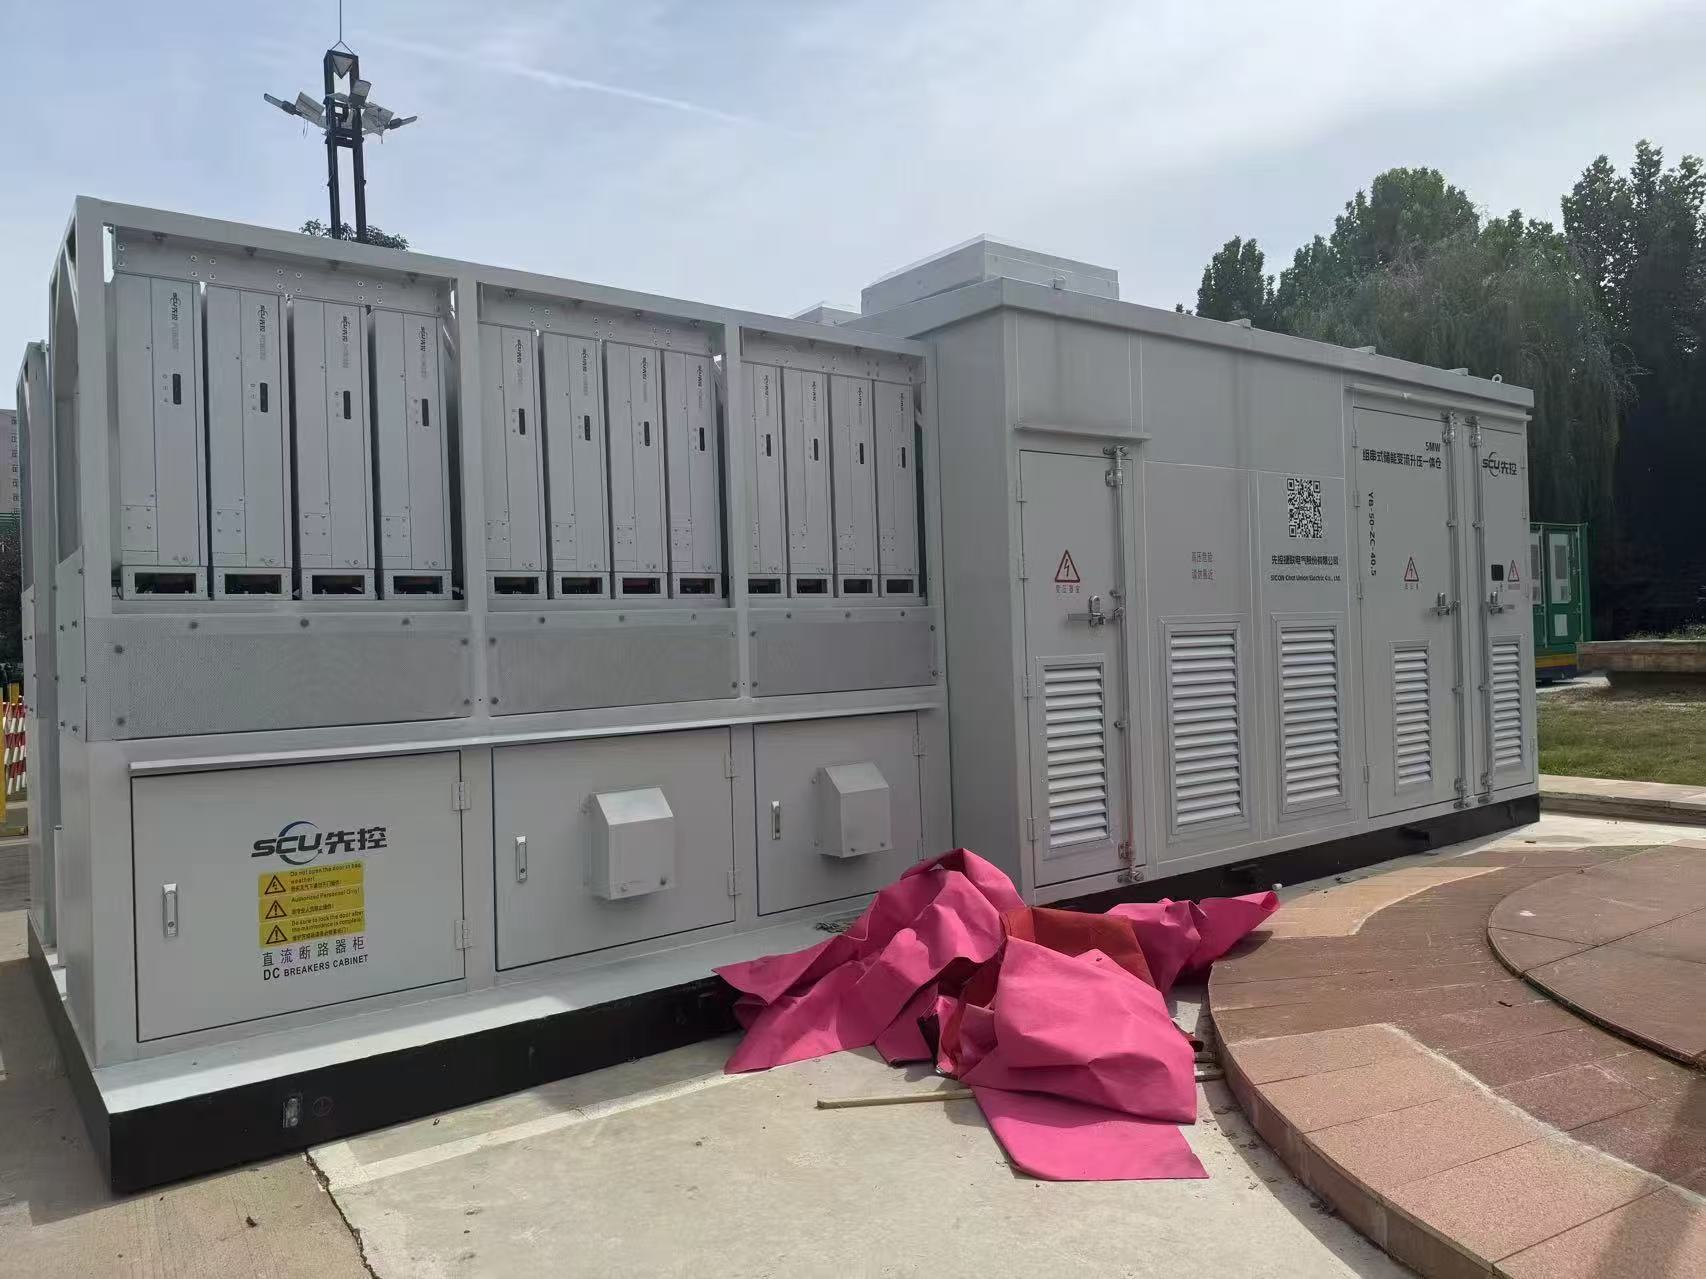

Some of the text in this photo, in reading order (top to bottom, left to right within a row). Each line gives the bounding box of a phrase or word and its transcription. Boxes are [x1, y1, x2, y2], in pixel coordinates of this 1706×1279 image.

[1425, 442, 1441, 452] 5MW
[1482, 456, 1518, 475] SCU 先控
[251, 826, 388, 860] SCU 先控
[262, 936, 365, 967] 直流断路器柜
[263, 954, 369, 981] DC BREAKERS CABINET
